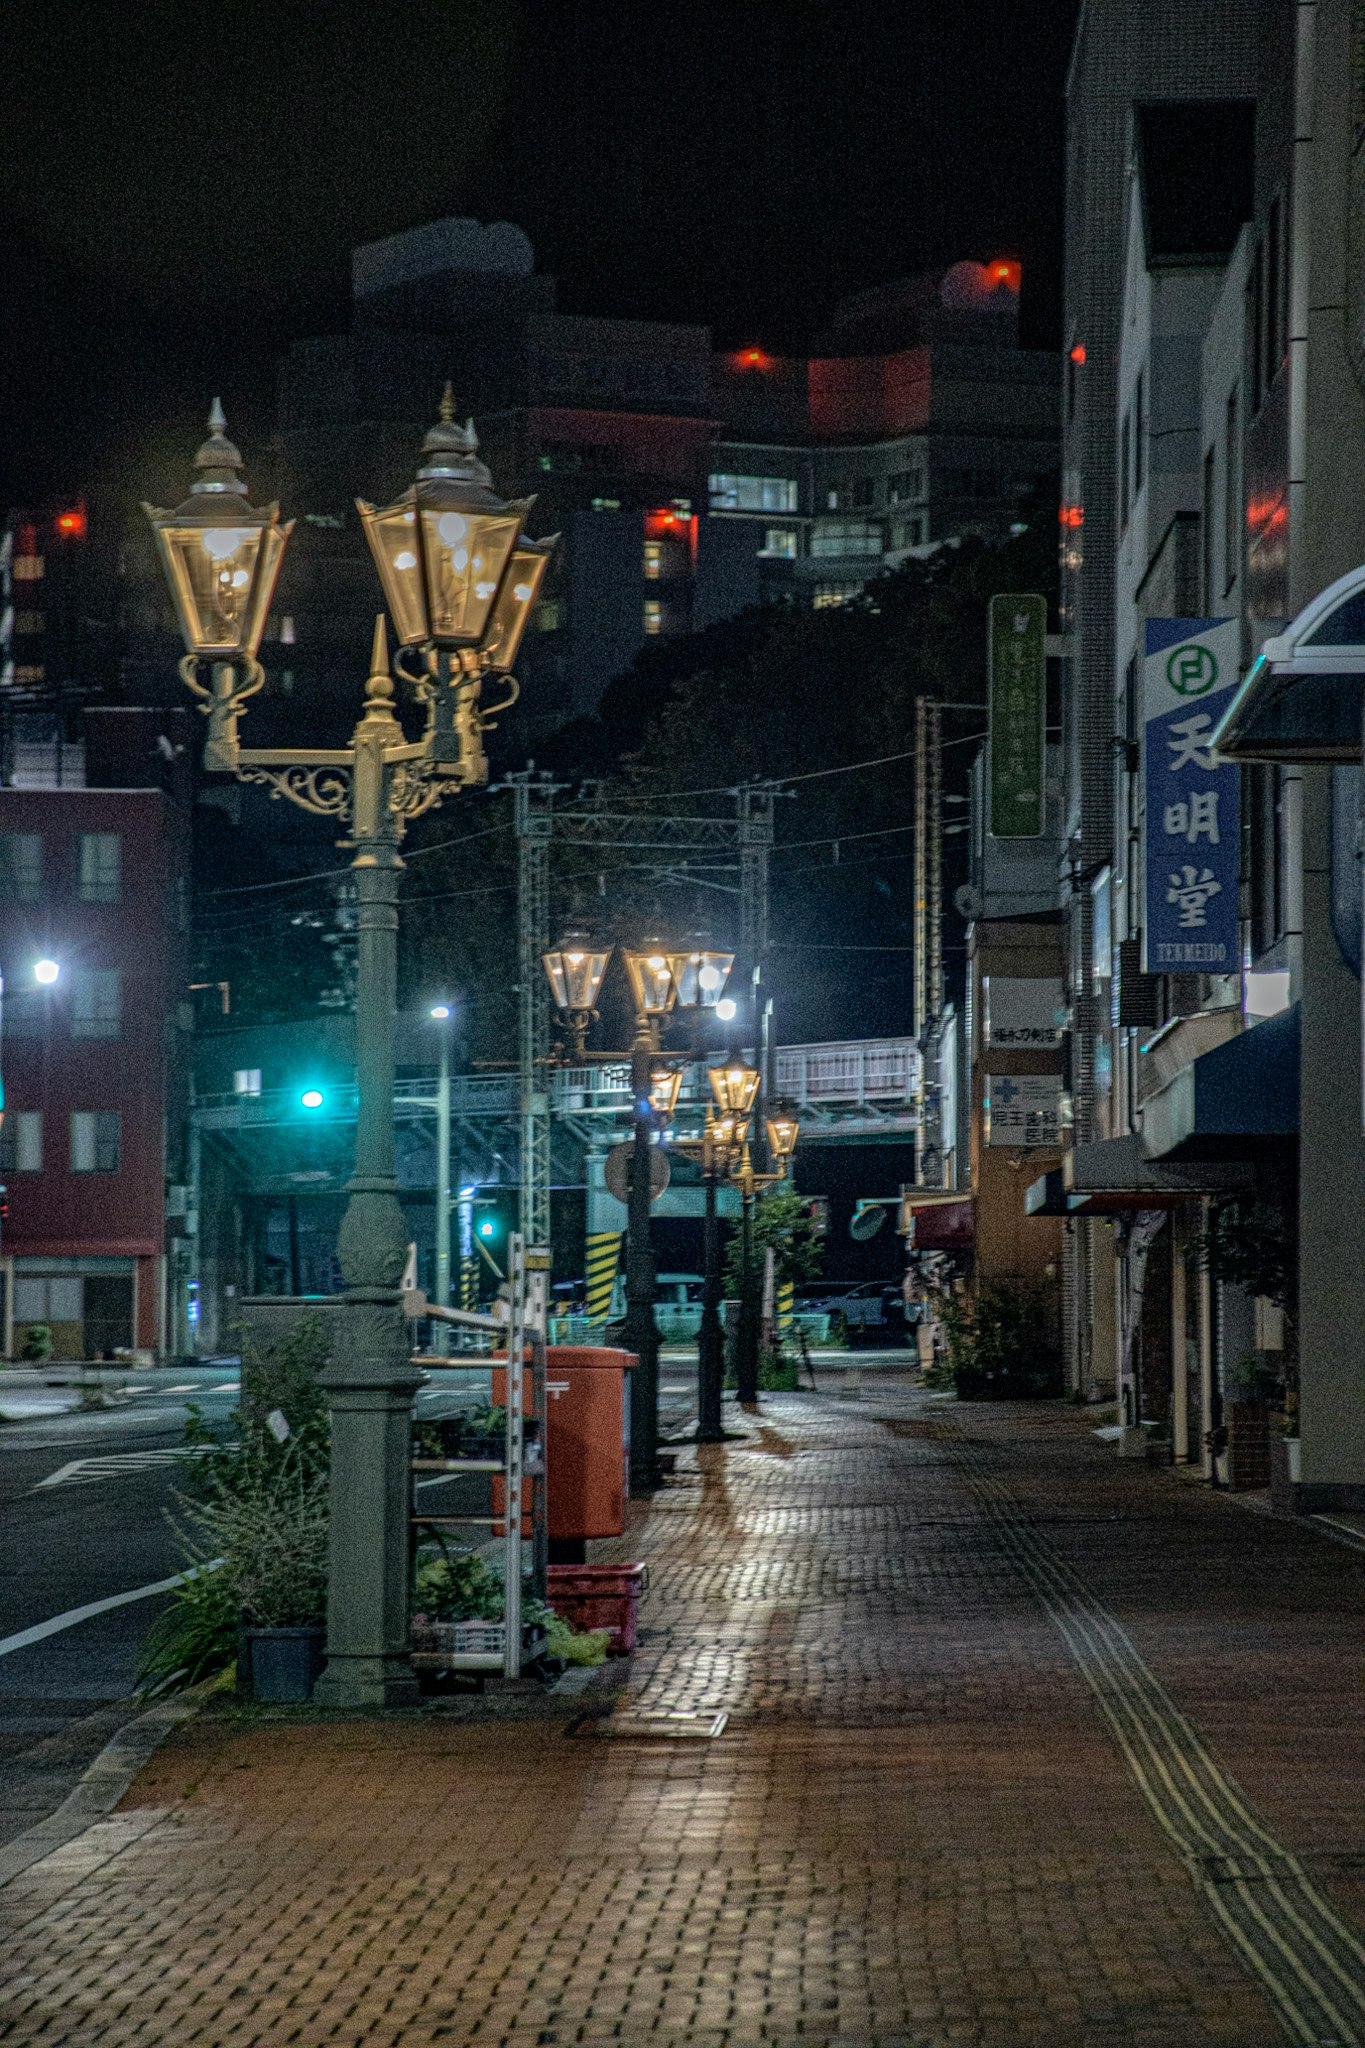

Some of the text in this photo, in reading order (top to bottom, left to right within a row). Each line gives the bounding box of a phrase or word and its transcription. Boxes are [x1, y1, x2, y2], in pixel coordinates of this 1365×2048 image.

[1164, 713, 1221, 928] 天明堂
[1156, 943, 1226, 962] TENMEIDO
[1026, 1128, 1058, 1143] 医院
